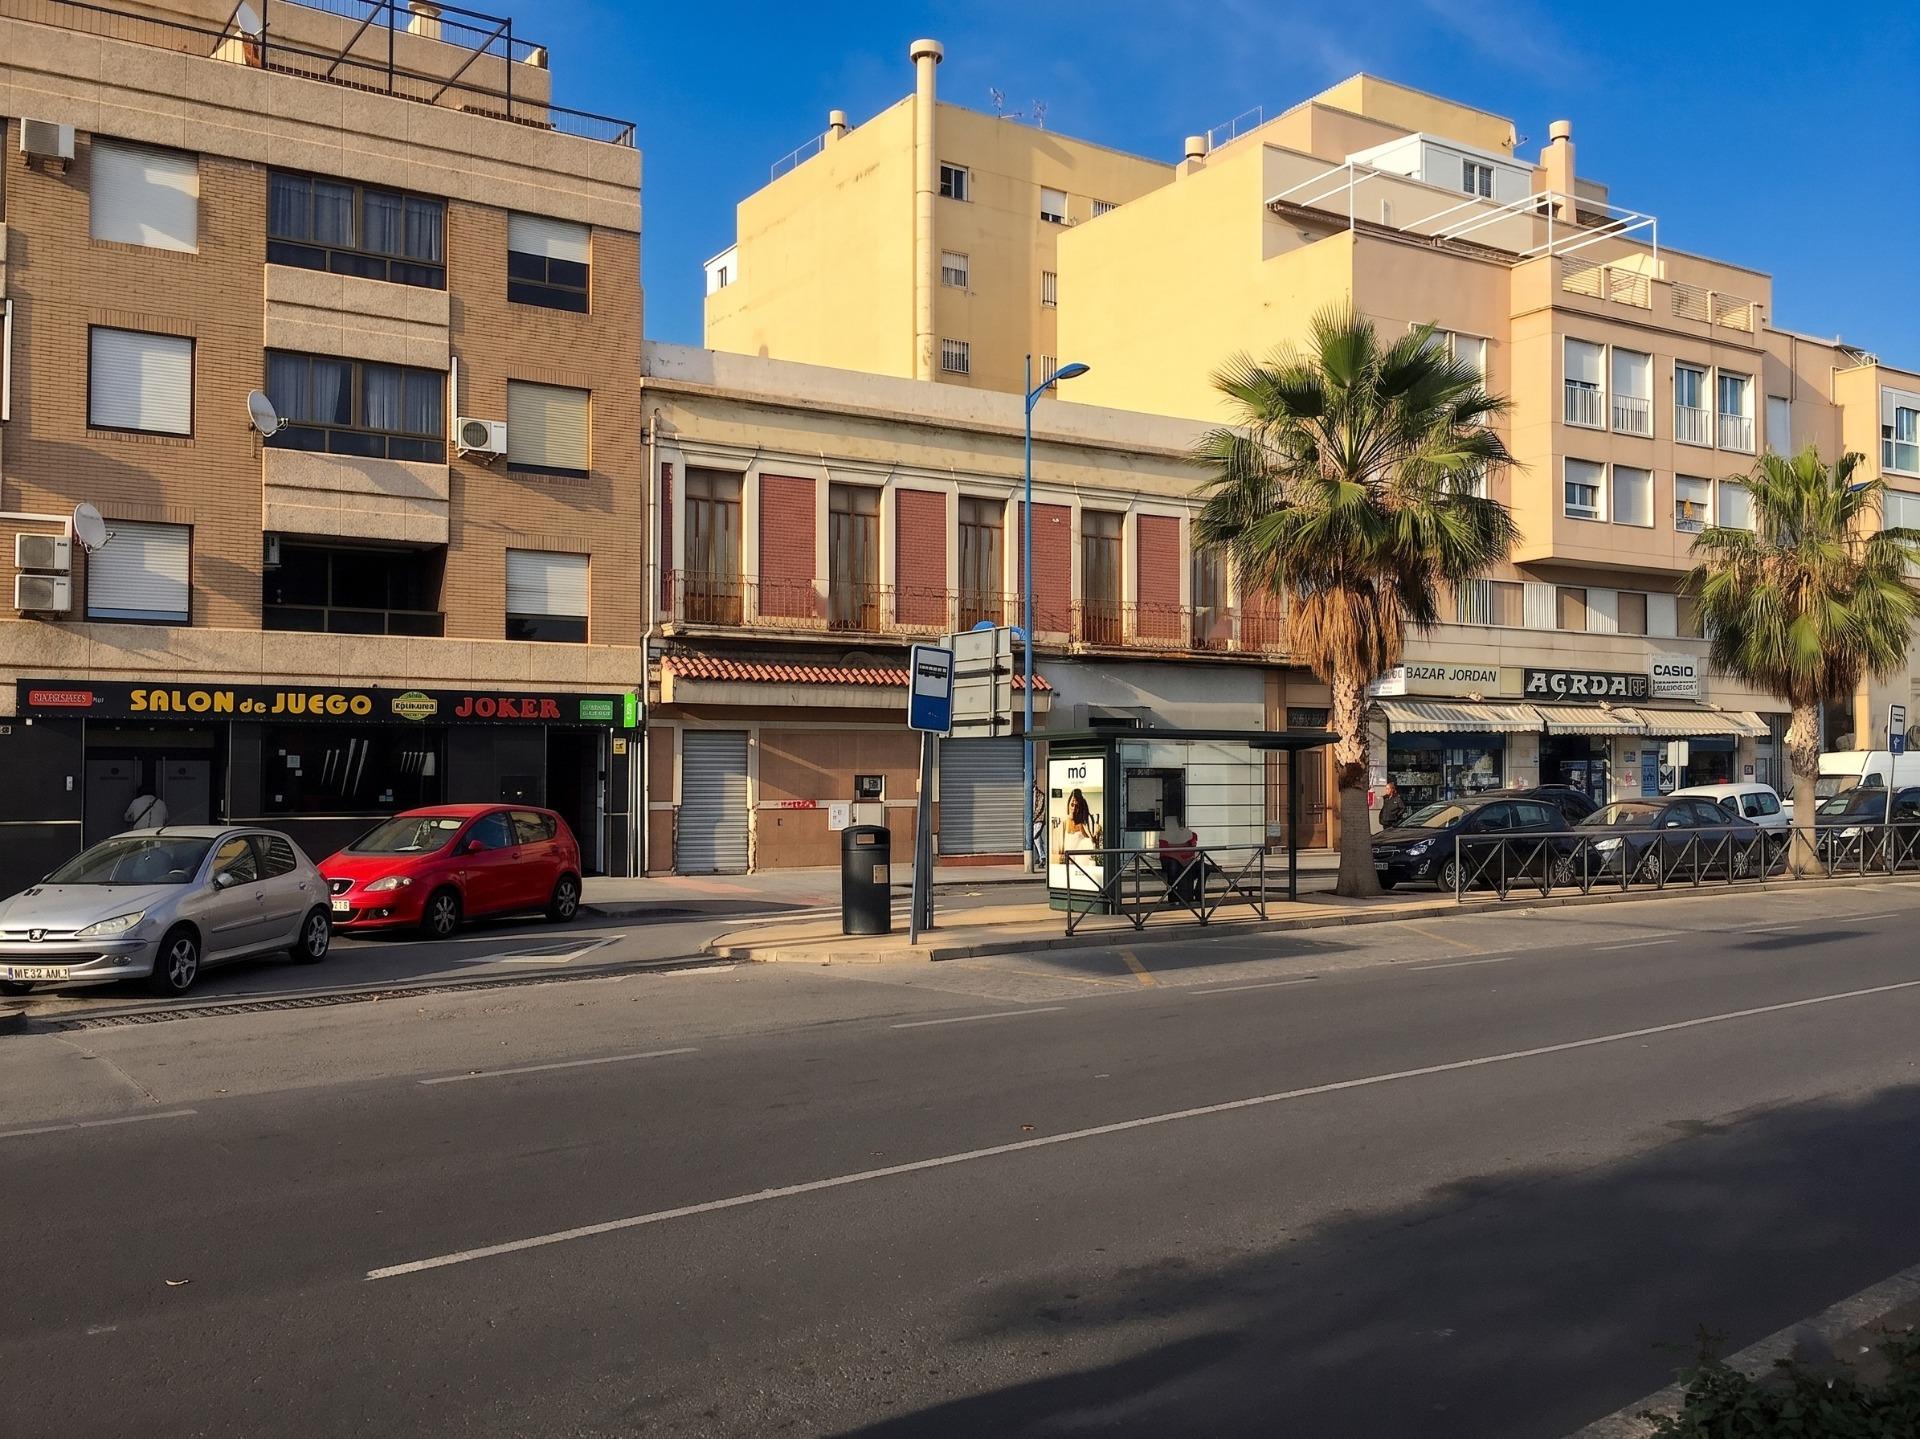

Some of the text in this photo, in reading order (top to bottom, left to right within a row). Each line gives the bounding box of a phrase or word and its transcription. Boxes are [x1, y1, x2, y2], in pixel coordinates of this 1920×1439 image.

[1406, 667, 1446, 680] BAZAR
[1449, 669, 1497, 682] JORDAN
[1653, 664, 1693, 677] CASIO
[1527, 672, 1627, 696] AGRDA
[130, 689, 372, 715] SALON de JUEGO
[455, 697, 561, 718] JOKER
[1067, 762, 1087, 779] mó
